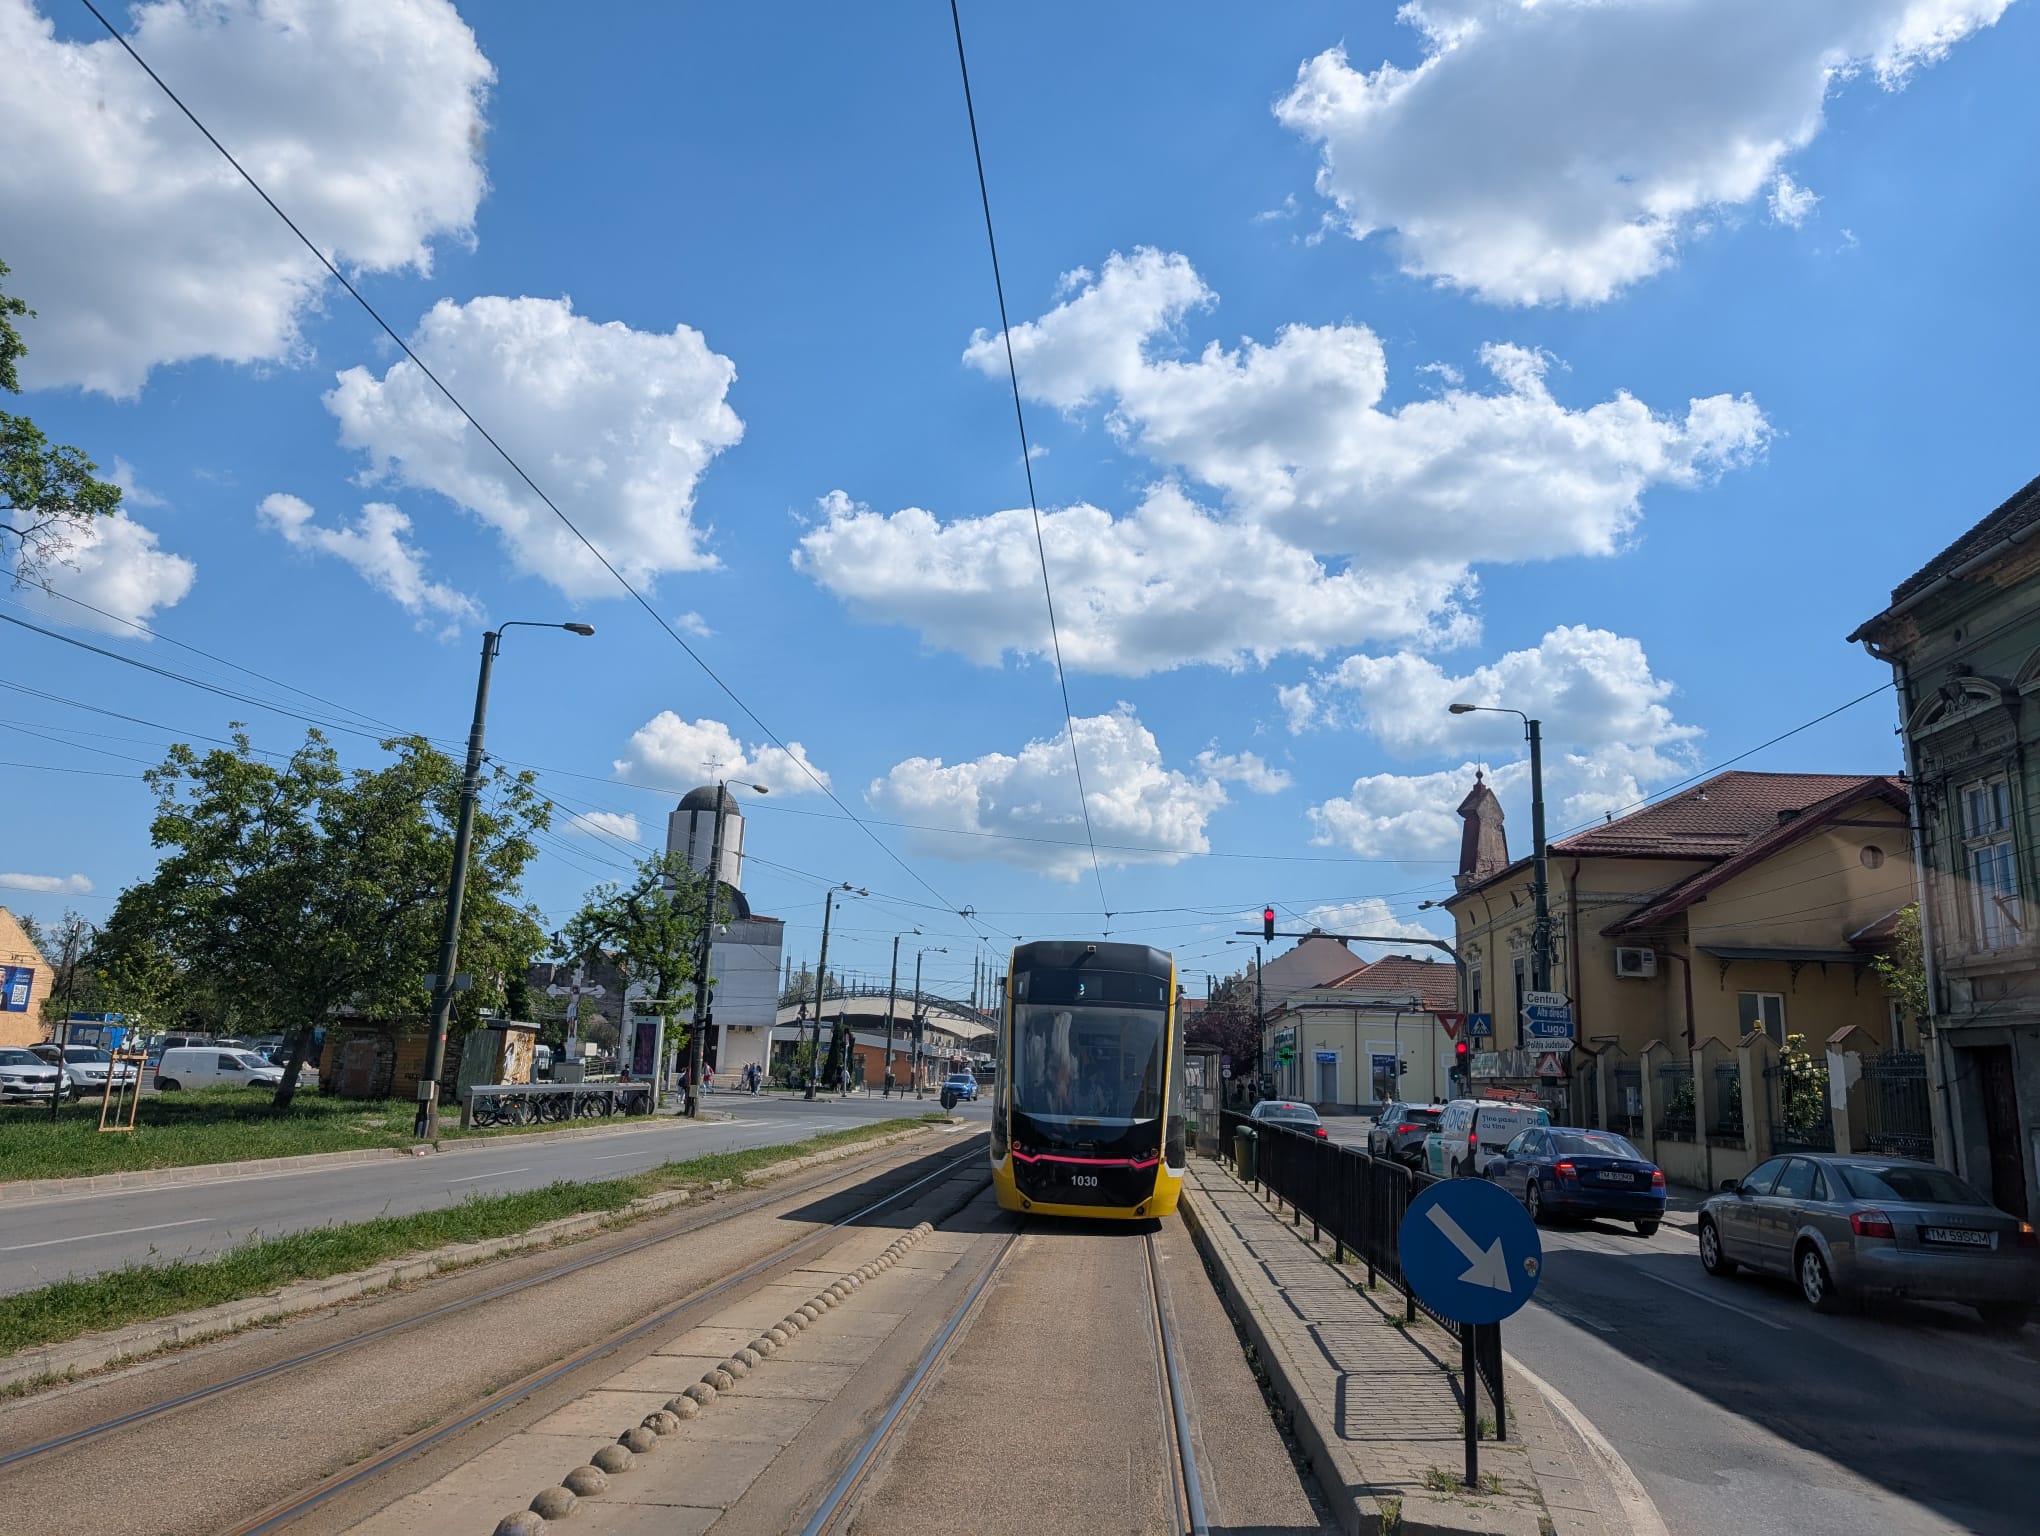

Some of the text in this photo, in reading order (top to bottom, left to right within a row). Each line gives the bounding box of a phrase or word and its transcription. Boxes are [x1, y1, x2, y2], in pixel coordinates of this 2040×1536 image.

[1527, 994, 1558, 1005] Centru
[1541, 1023, 1568, 1037] Lugoj
[1527, 1117, 1545, 1126] DIGI
[1071, 1175, 1098, 1187] 1030
[1931, 1229, 1989, 1243] TM 59SCM
